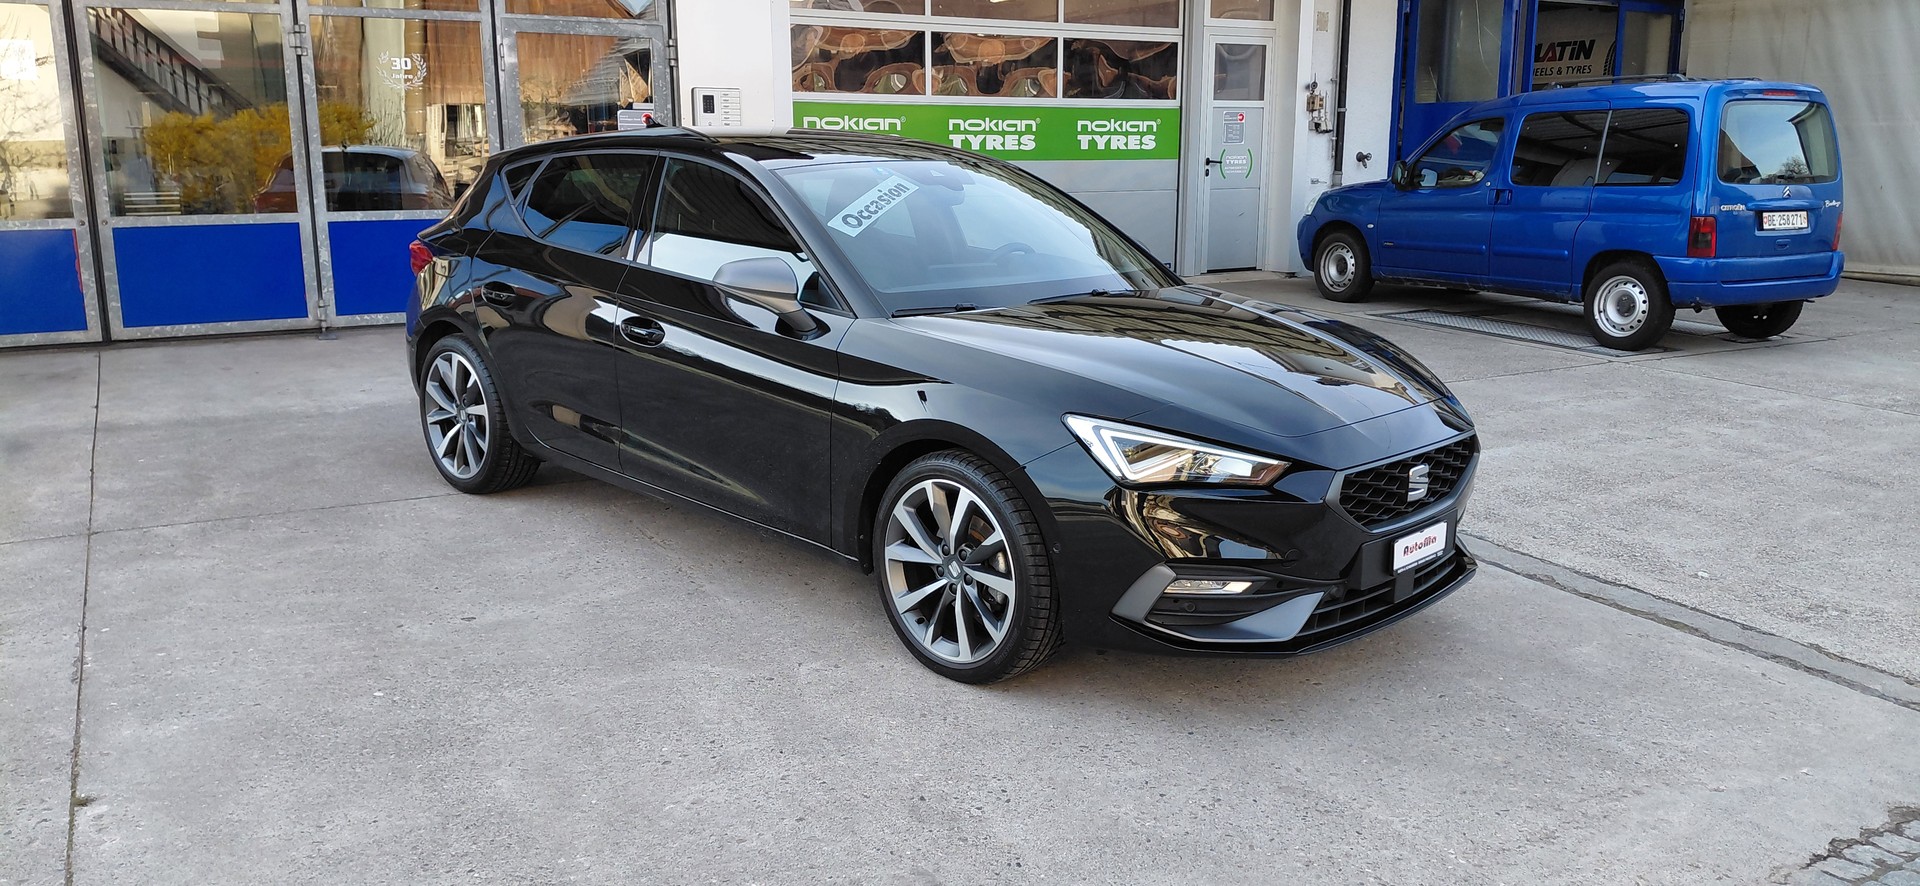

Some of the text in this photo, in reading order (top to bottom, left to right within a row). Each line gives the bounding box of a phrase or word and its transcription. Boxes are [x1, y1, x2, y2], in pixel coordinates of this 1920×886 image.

[1534, 40, 1596, 62] LATiN
[390, 58, 412, 70] 30
[1556, 66, 1563, 75] &
[1566, 65, 1592, 75] TYRES
[948, 134, 1037, 151] TYRES
[1077, 134, 1157, 150] TYRES
[841, 183, 911, 229] Occasion
